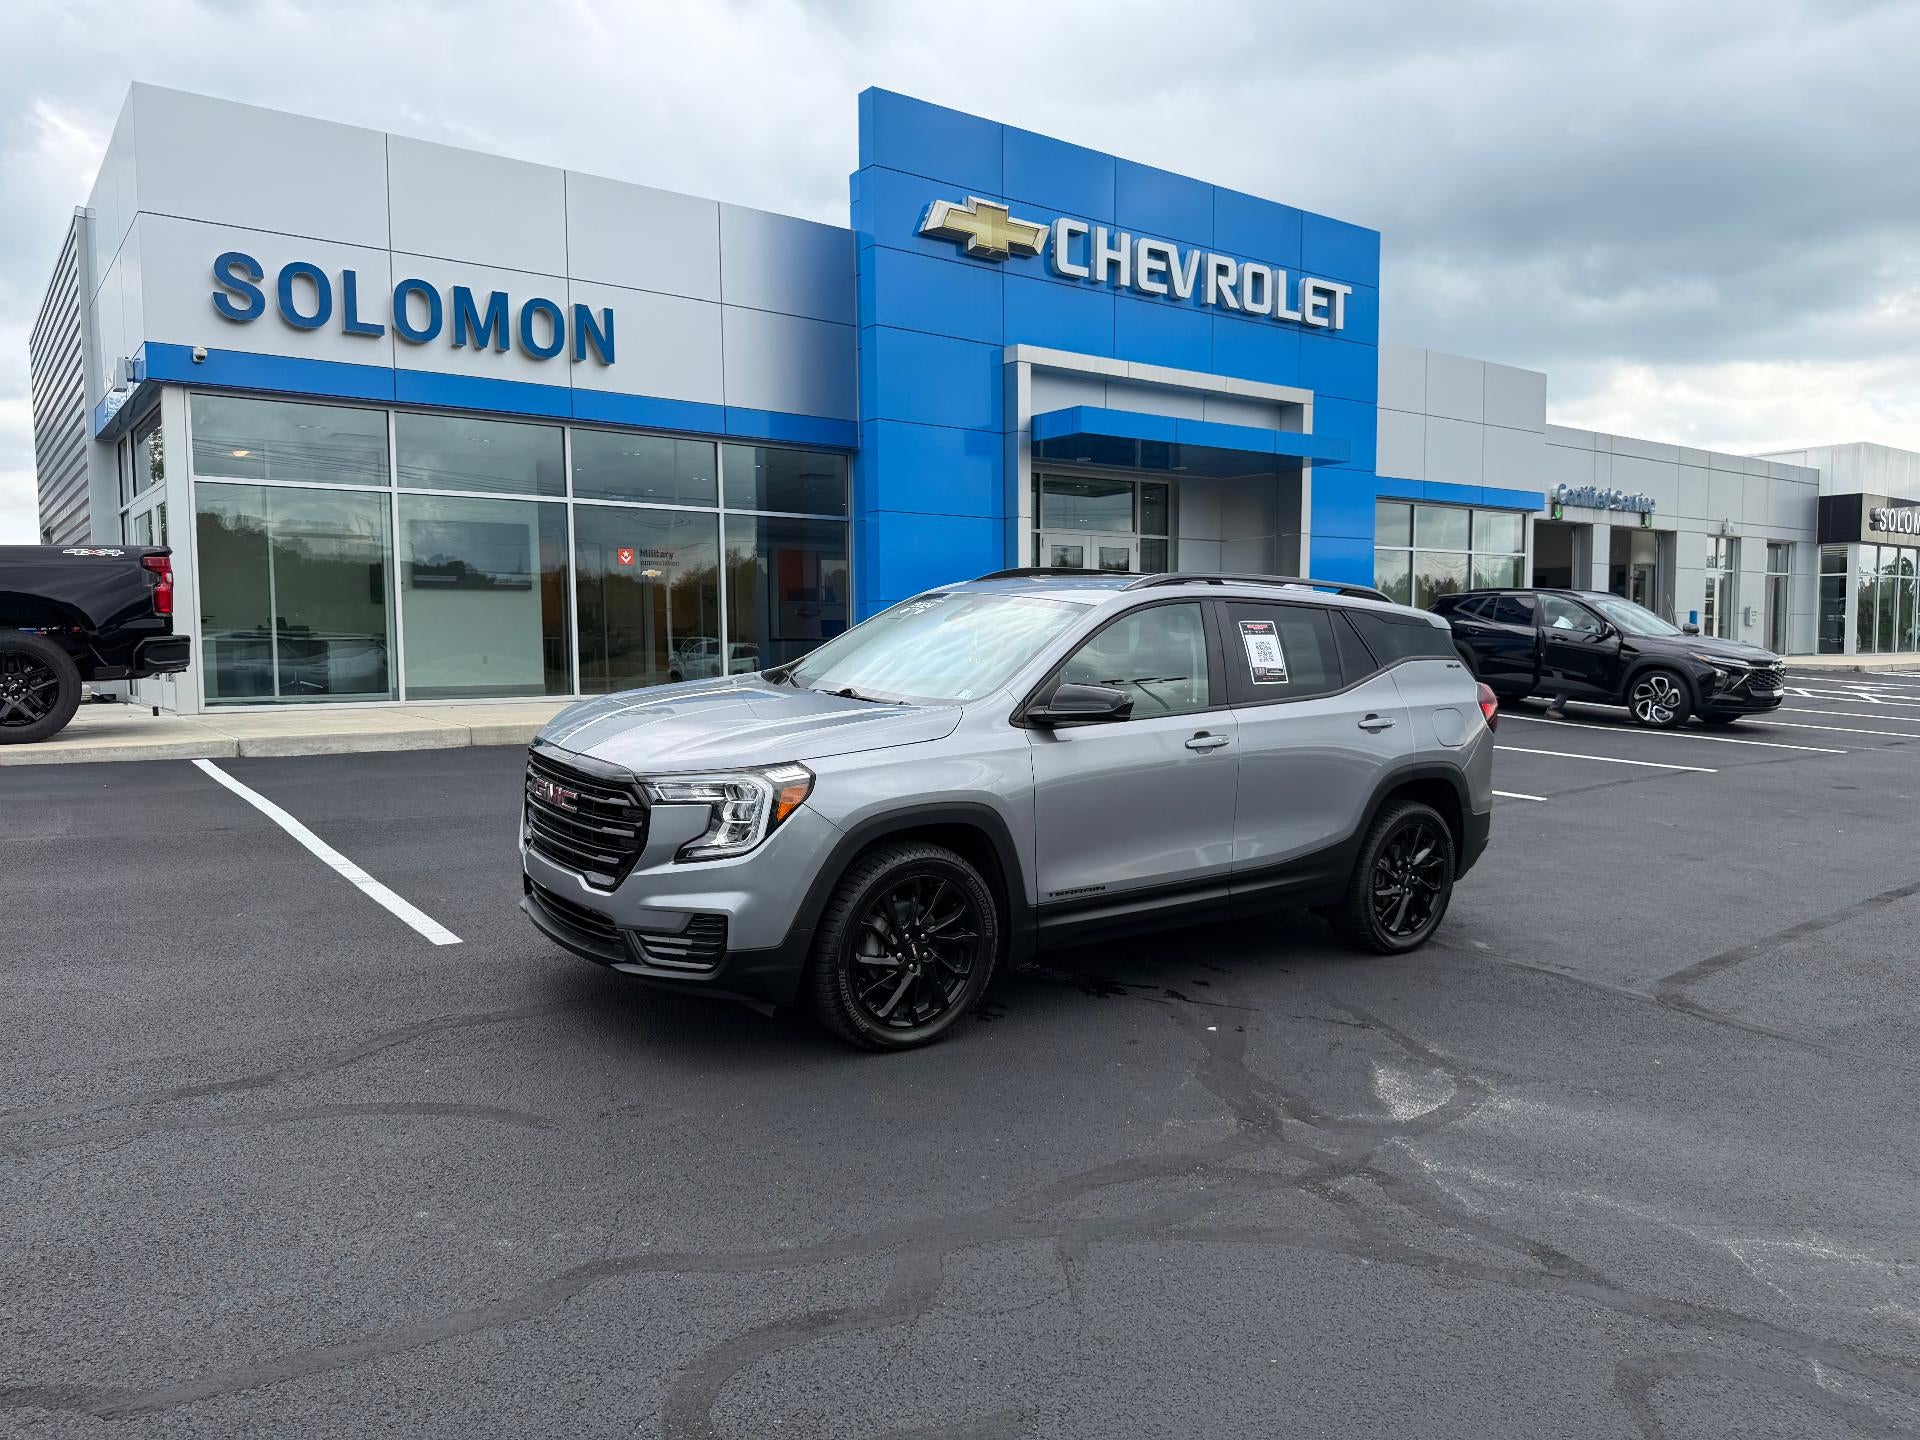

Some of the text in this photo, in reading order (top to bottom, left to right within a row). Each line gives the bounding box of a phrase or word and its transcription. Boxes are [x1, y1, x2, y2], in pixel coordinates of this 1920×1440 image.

[1050, 217, 1352, 330] CHEVROLET
[212, 251, 615, 365] SOLOMON
[1557, 483, 1656, 512] Certified Service
[640, 549, 675, 559] Military
[534, 778, 578, 813] GMC
[966, 876, 993, 938] BRIDGESTONE
[1047, 885, 1106, 897] TERRAIN
[838, 968, 870, 1032] BRIDGESTONE
